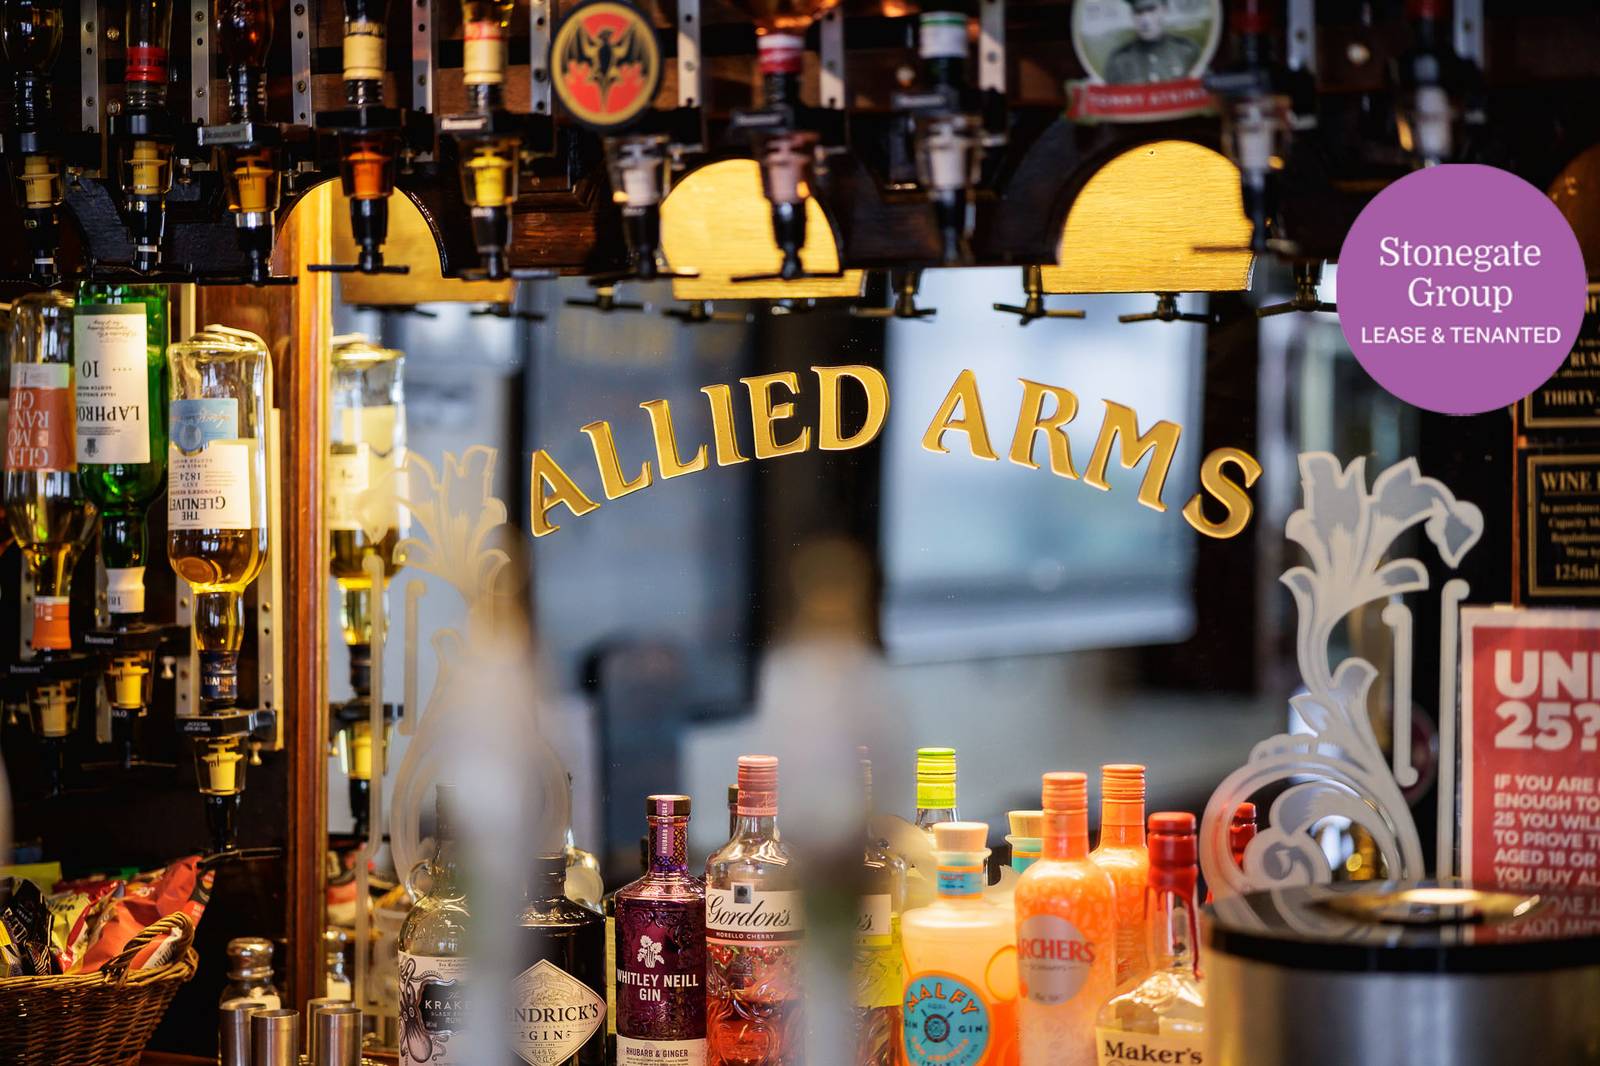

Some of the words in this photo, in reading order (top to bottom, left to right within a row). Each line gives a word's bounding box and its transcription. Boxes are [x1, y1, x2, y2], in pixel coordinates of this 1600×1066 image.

[82, 360, 99, 378] 10
[76, 405, 140, 421] LAPHRO
[530, 363, 891, 538] ALLIED
[920, 368, 1264, 540] ARMS
[179, 472, 201, 481] 1824
[1541, 471, 1591, 491] WINE
[182, 511, 200, 520] THE
[1494, 700, 1600, 751] 25?
[1494, 774, 1511, 790] IF
[1515, 775, 1553, 792] YOU
[1556, 778, 1593, 794] ARE
[1494, 792, 1571, 811] ENOUGH
[1576, 797, 1600, 813] TO
[1493, 811, 1516, 828] 25
[1520, 813, 1557, 830] YOU
[1493, 830, 1519, 846] TO
[1522, 832, 1584, 849] PROVE
[1494, 848, 1544, 865] AGED
[1549, 851, 1566, 867] 18
[1570, 853, 1596, 868] OR
[1494, 866, 1532, 884] YOU
[1536, 870, 1574, 887] BUY
[716, 931, 744, 939] MORELLO
[616, 968, 660, 987] WHITLEY
[663, 974, 700, 988] NEILL
[639, 988, 661, 1002] GIN
[507, 1003, 598, 1023] NDRICK'S
[529, 1030, 563, 1041] GIN
[958, 1025, 983, 1034] GIN
[626, 1047, 653, 1057] RHUBARB
[662, 1049, 688, 1058] GINGER
[1104, 1039, 1203, 1066] Maker's
